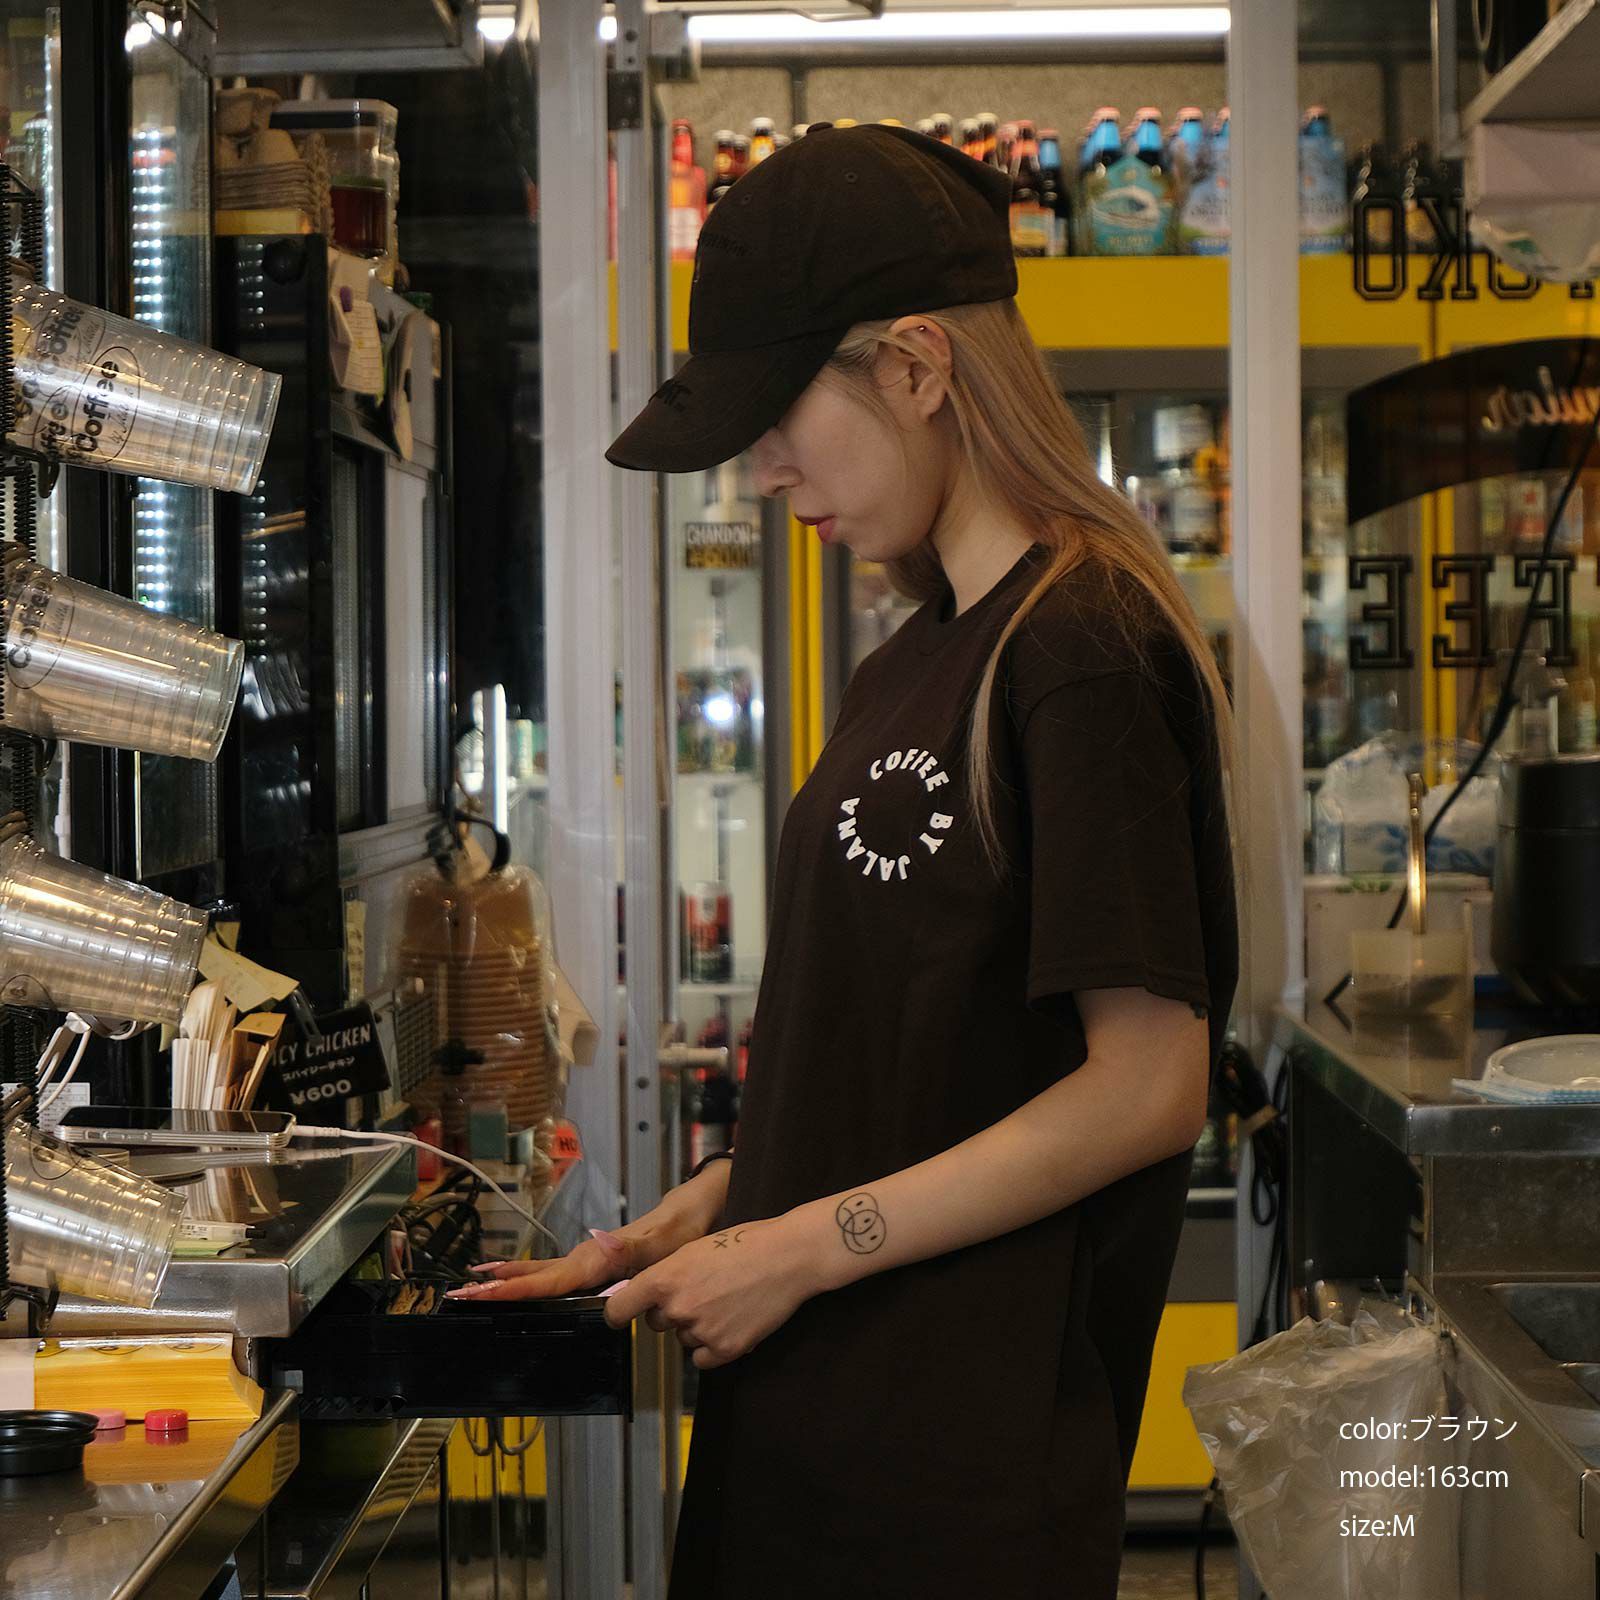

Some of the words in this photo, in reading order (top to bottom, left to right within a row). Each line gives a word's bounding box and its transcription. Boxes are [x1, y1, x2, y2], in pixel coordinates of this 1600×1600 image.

[75, 360, 120, 452] Coffee
[870, 748, 950, 792] COFFEE
[837, 797, 911, 882] JALANA
[919, 812, 954, 855] BY
[272, 1042, 298, 1066] ICY
[305, 1023, 371, 1058] CHICKEN
